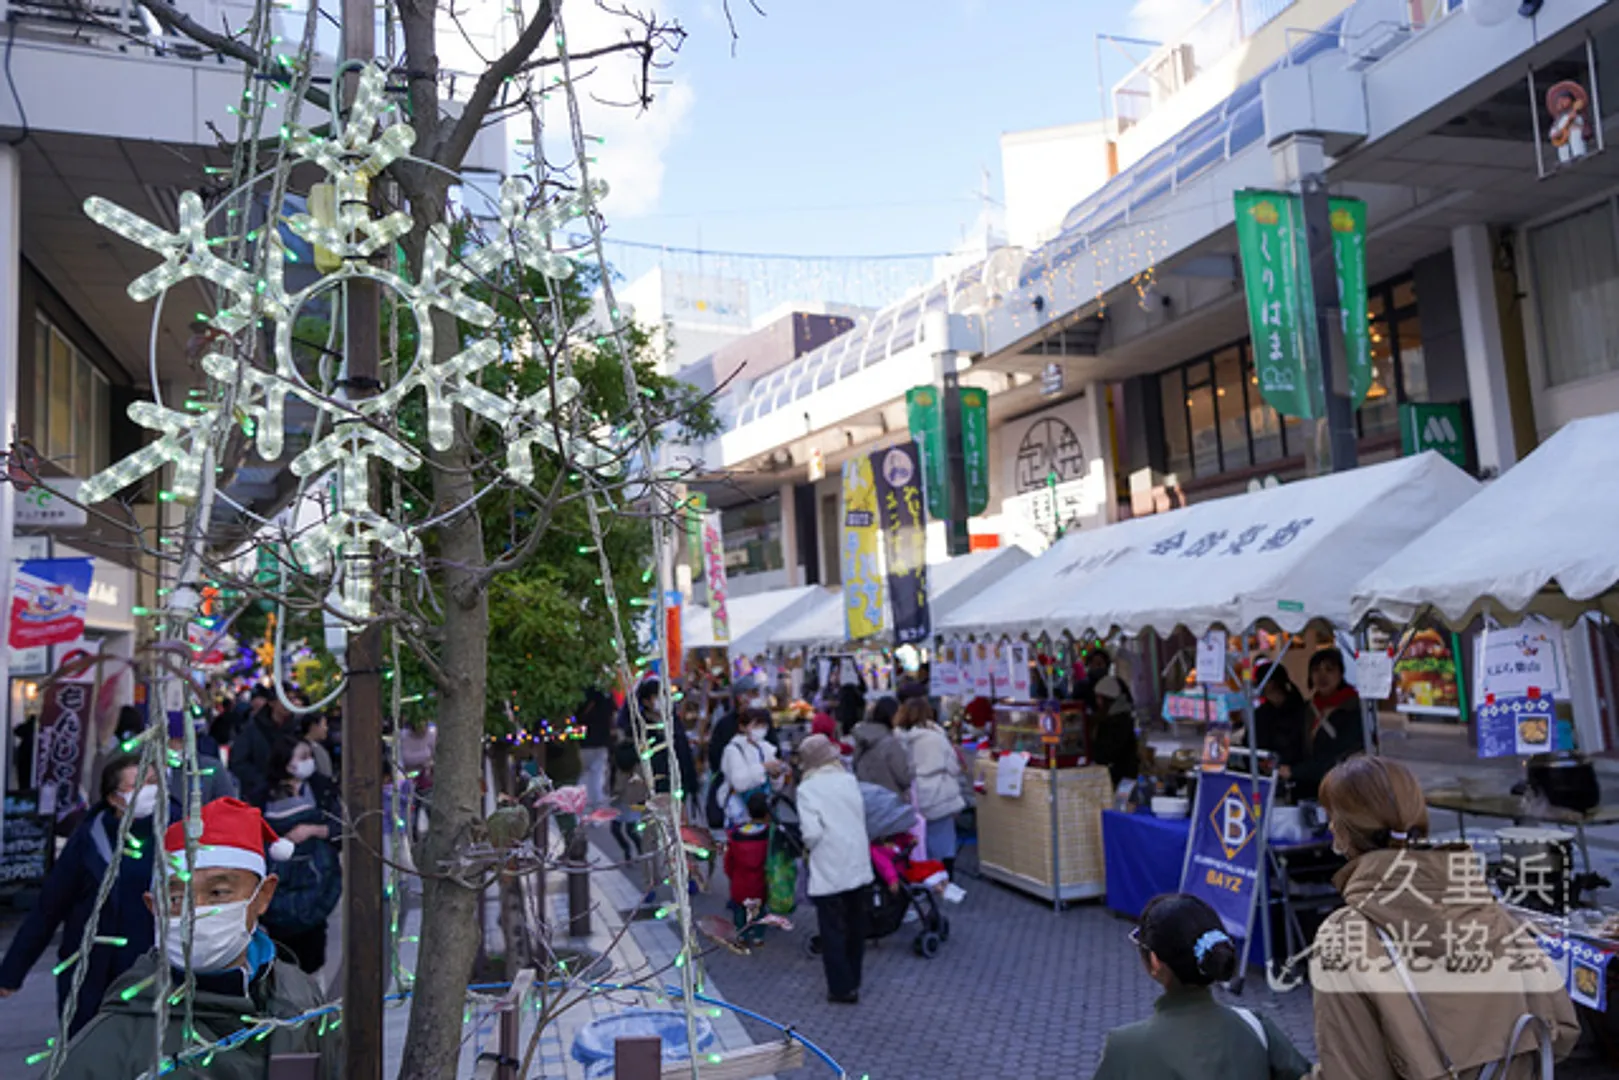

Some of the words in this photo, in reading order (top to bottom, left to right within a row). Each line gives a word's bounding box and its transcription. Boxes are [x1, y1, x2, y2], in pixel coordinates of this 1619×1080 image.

[1260, 231, 1284, 361] くりはま
[1223, 797, 1247, 846] B
[1205, 868, 1243, 893] BAYZ
